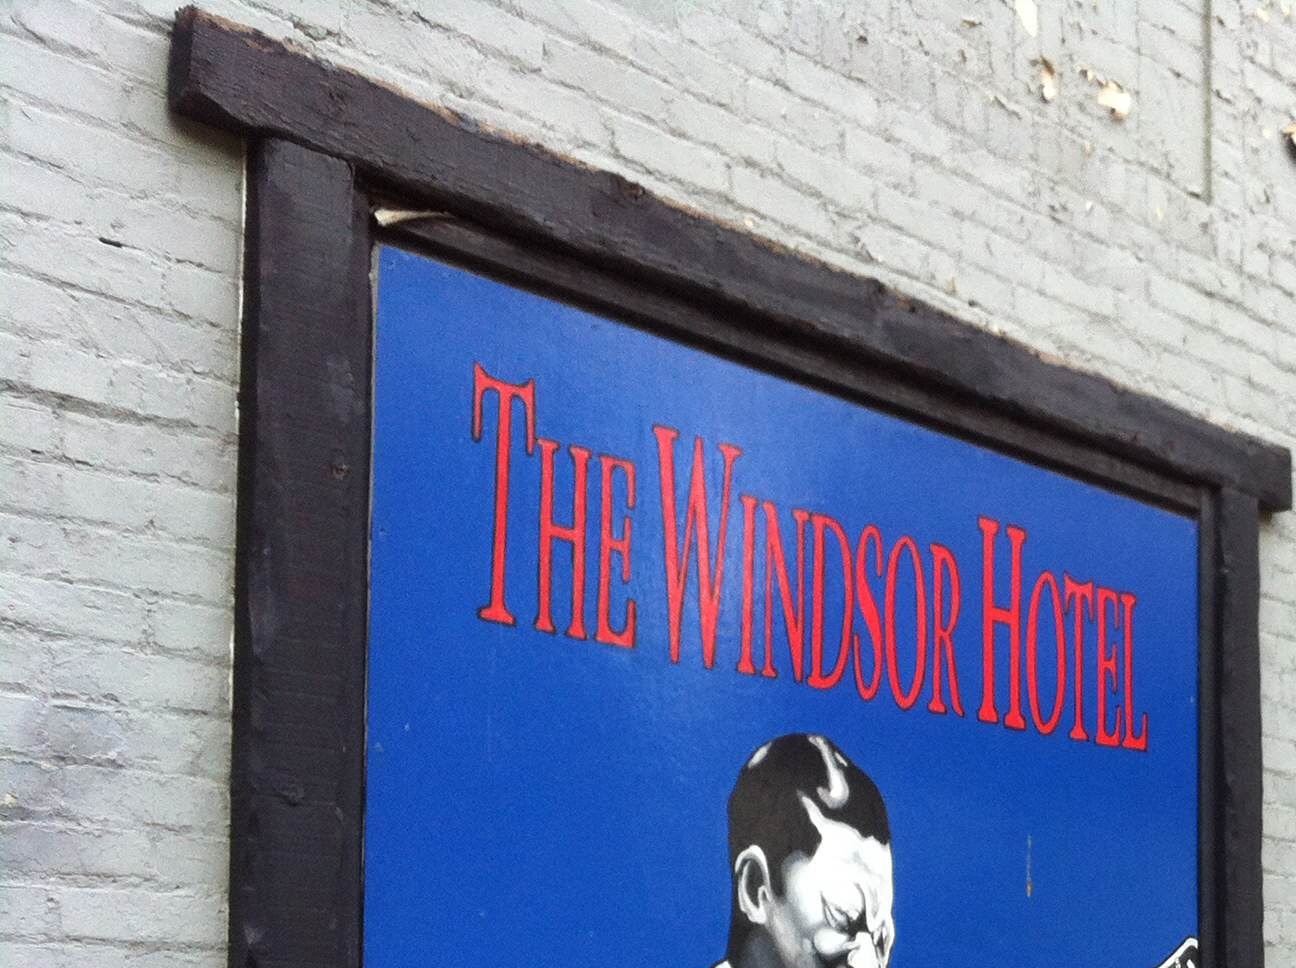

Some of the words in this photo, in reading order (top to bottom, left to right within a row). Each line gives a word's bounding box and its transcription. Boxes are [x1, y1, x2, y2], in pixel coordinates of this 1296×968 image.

[471, 361, 637, 649] THE
[652, 424, 966, 718] WINDSOR
[977, 515, 1149, 752] HOTEL
